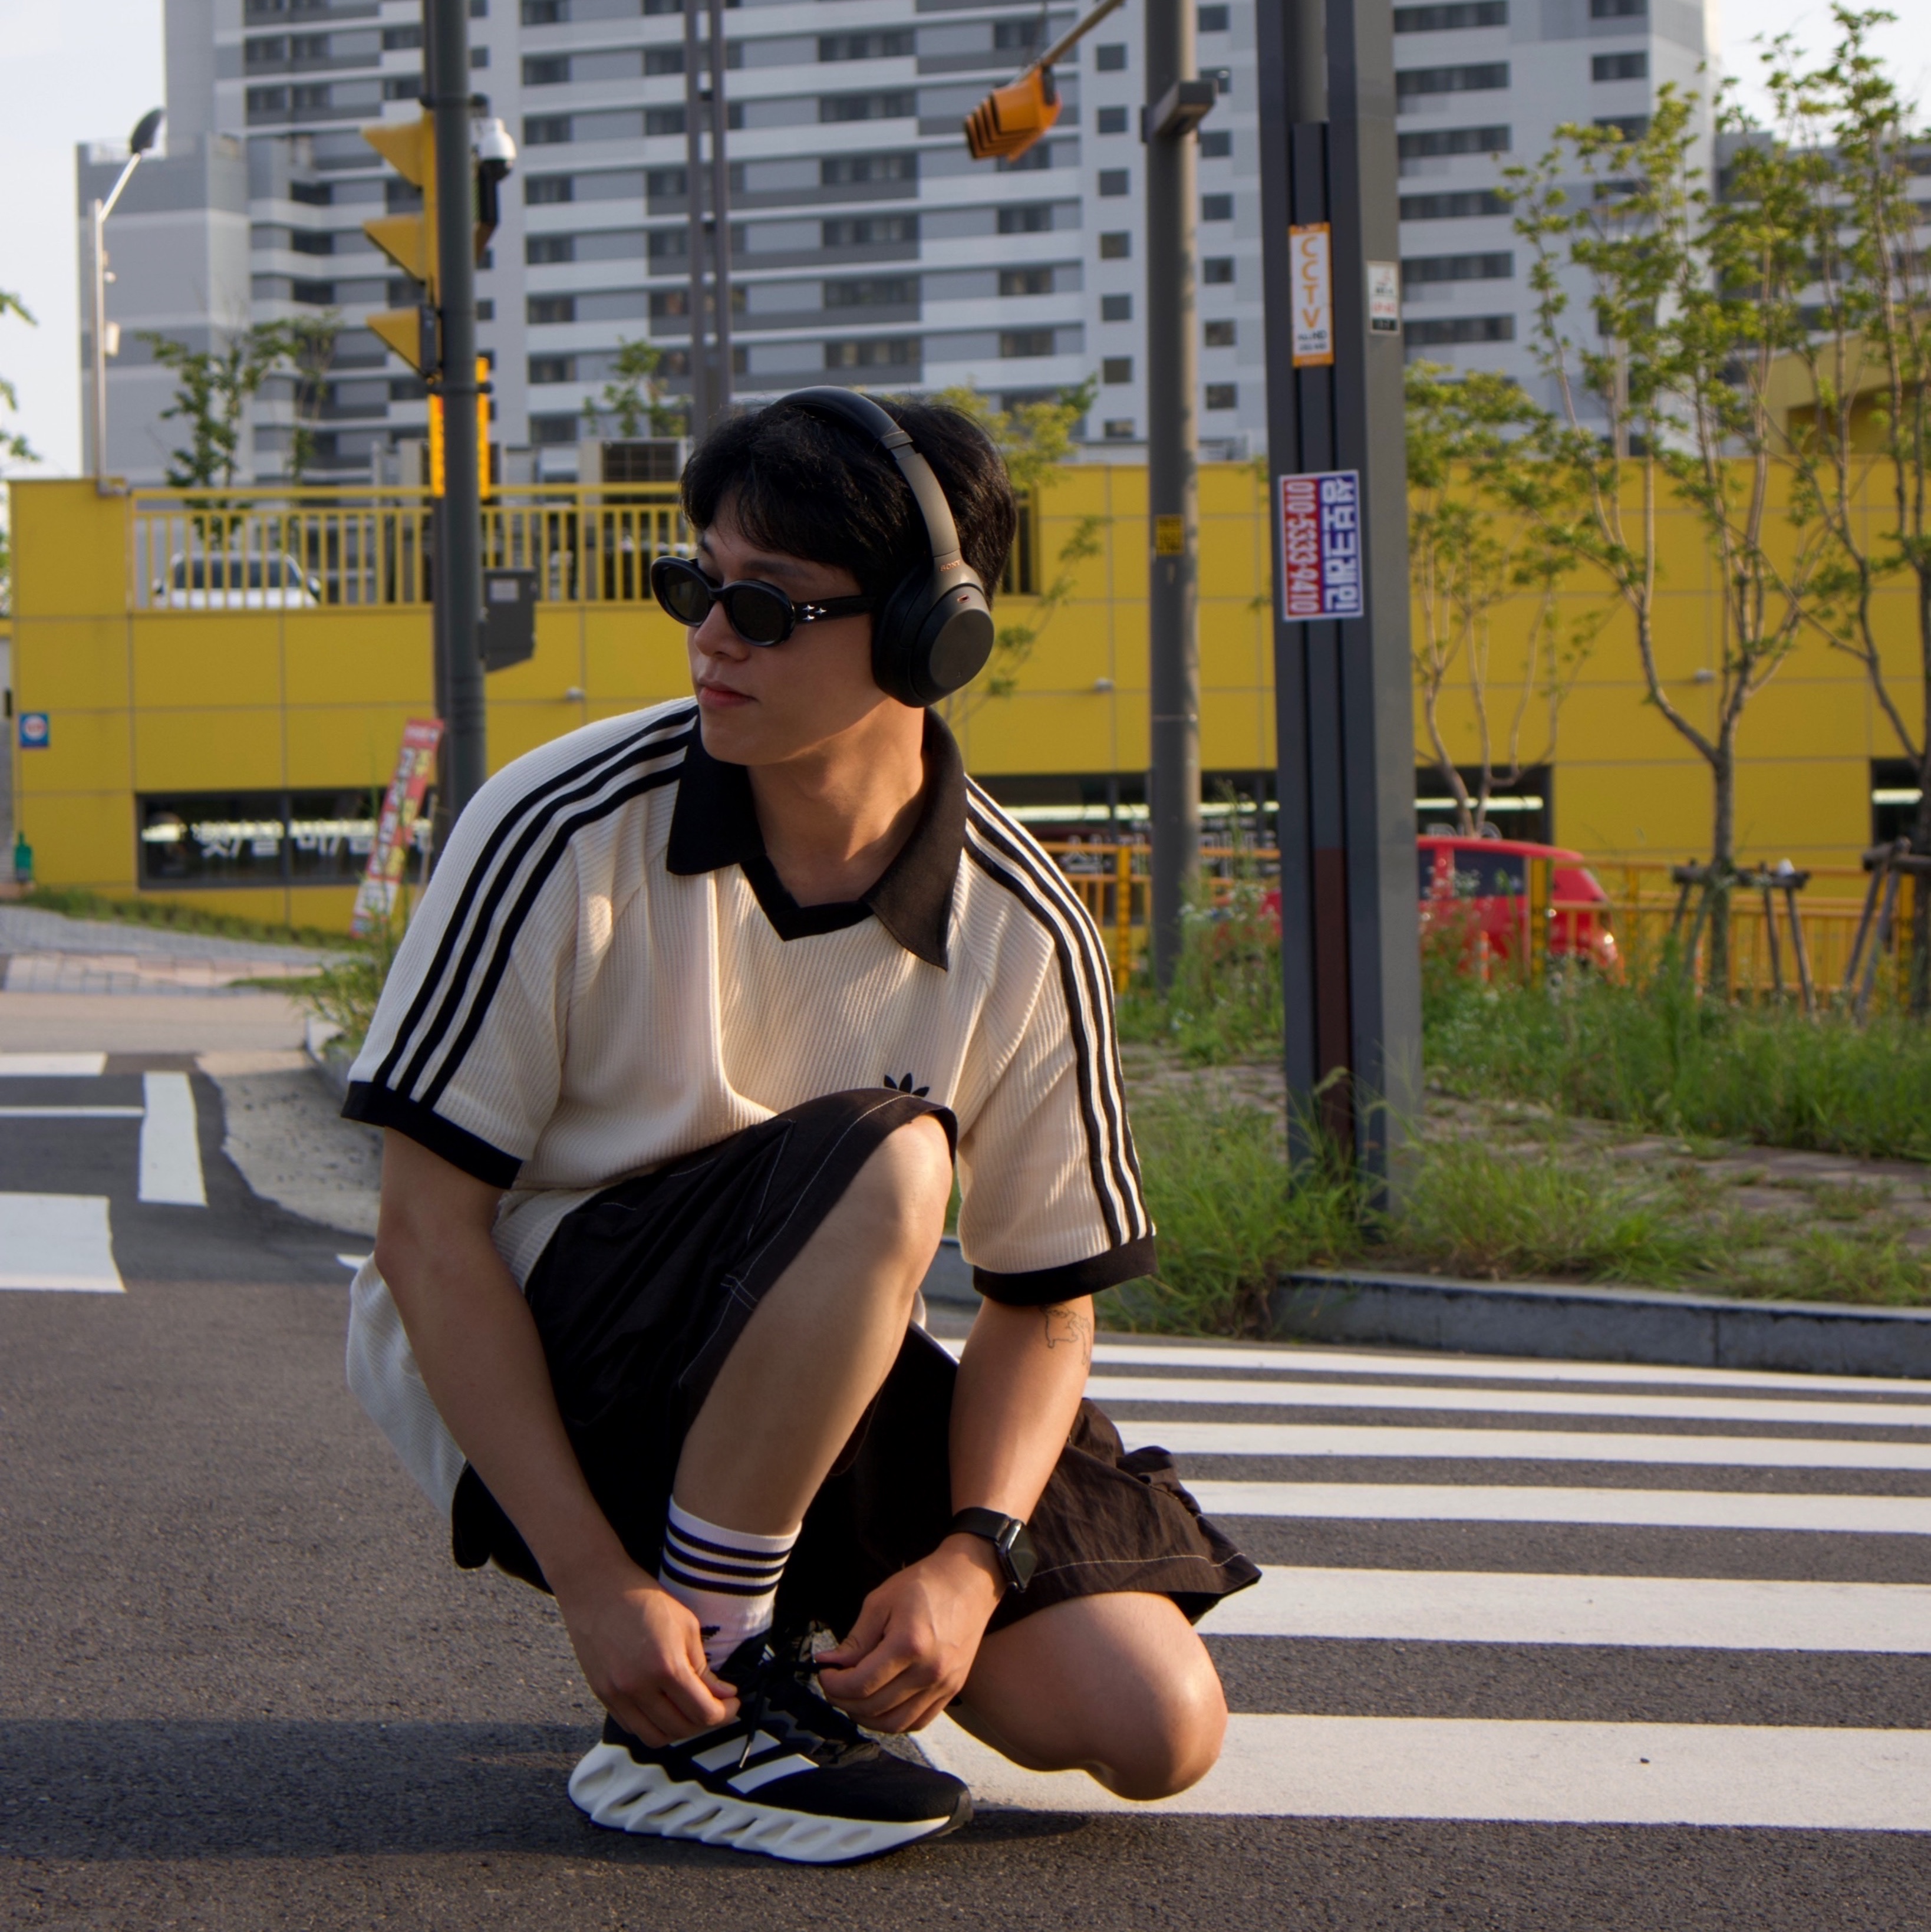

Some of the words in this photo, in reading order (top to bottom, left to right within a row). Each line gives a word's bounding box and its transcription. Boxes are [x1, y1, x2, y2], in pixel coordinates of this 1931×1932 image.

[1301, 236, 1320, 328] CCTV
[941, 559, 960, 571] SONY
[1287, 481, 1319, 613] 010-5333-9410
[1322, 477, 1357, 611] 성보크레인
